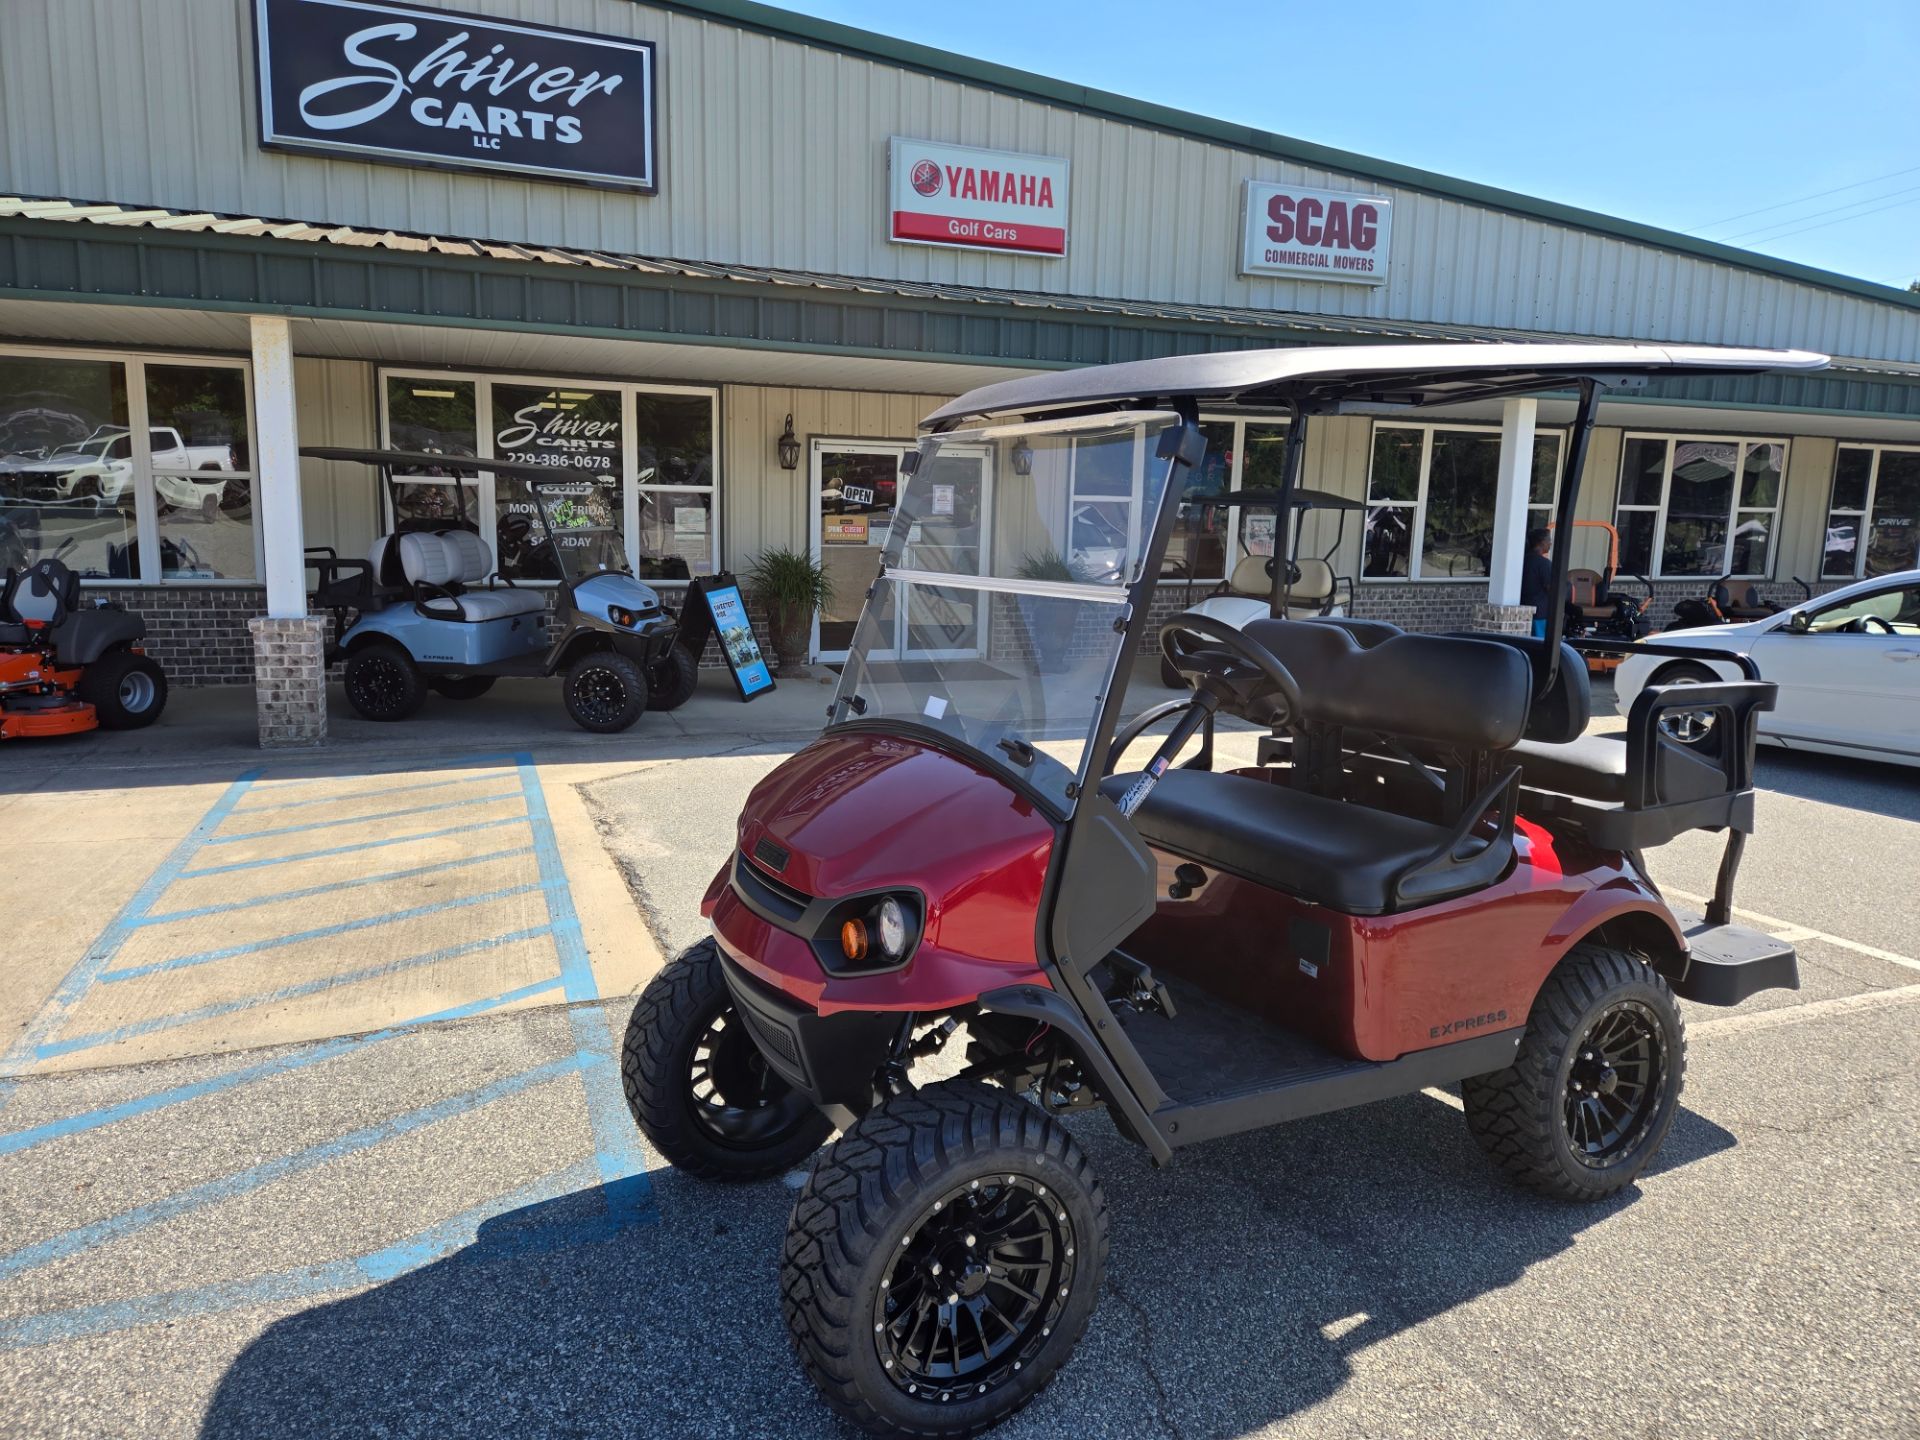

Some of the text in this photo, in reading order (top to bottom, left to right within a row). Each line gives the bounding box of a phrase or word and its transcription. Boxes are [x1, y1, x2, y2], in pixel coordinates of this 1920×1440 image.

[299, 22, 623, 130] Shiver
[410, 97, 583, 144] CARTS
[473, 135, 501, 150] LLC
[945, 165, 1054, 209] YAMAHA
[948, 219, 1017, 242] Golf Cars
[1266, 194, 1378, 251] SCAG
[1264, 248, 1374, 272] COMMERCIAL MOWERS
[497, 402, 619, 448] Shiver
[536, 437, 616, 449] CARTS
[507, 452, 611, 468] 229-386-0678
[845, 487, 871, 503] OPEN
[532, 519, 557, 529] 8:0
[1878, 518, 1912, 526] DRIVE
[530, 536, 592, 547] SARDAY
[1430, 1010, 1508, 1039] EXPRESS
